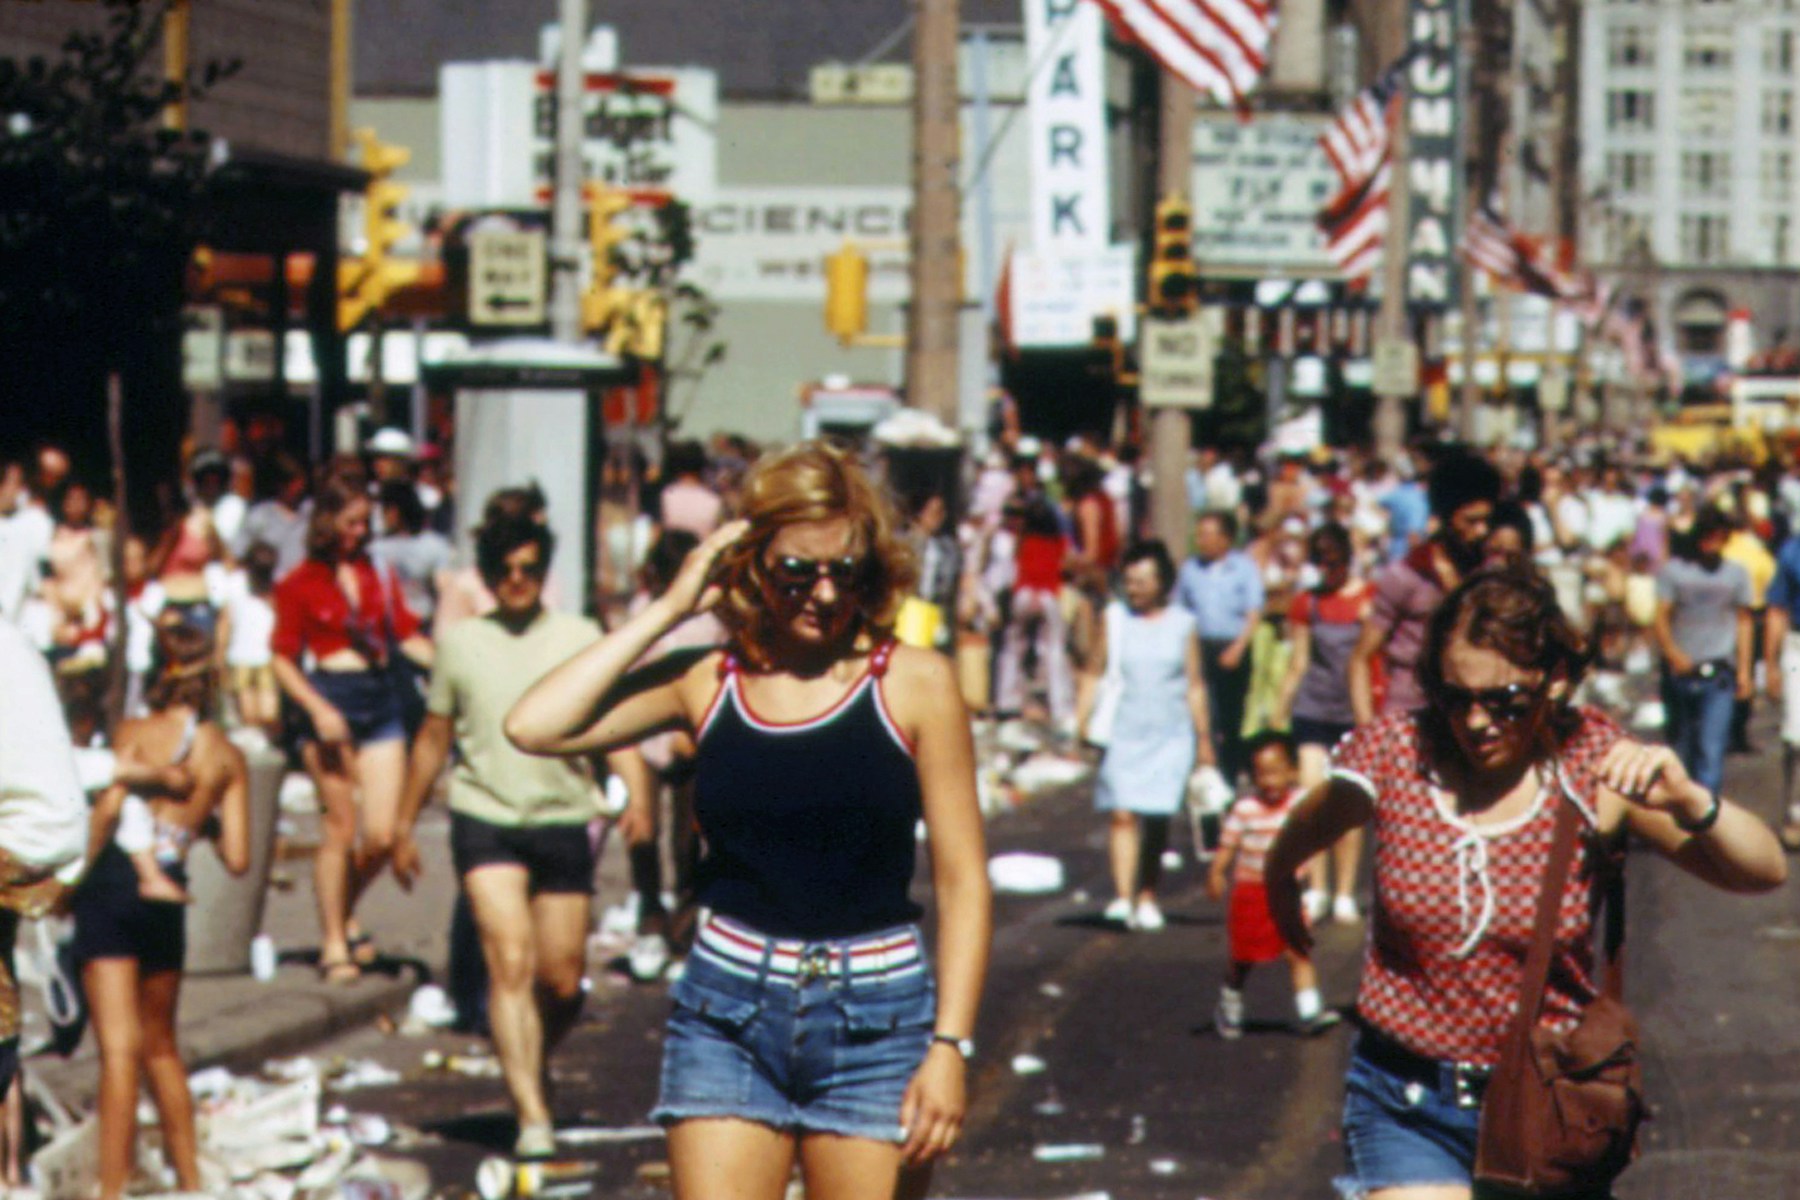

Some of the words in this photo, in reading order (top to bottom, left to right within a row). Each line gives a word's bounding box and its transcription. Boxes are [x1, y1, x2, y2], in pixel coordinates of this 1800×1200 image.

[535, 93, 673, 149] Bdget
[1045, 0, 1085, 236] PARK
[698, 205, 910, 234] CIENC
[1156, 333, 1199, 357] NO
